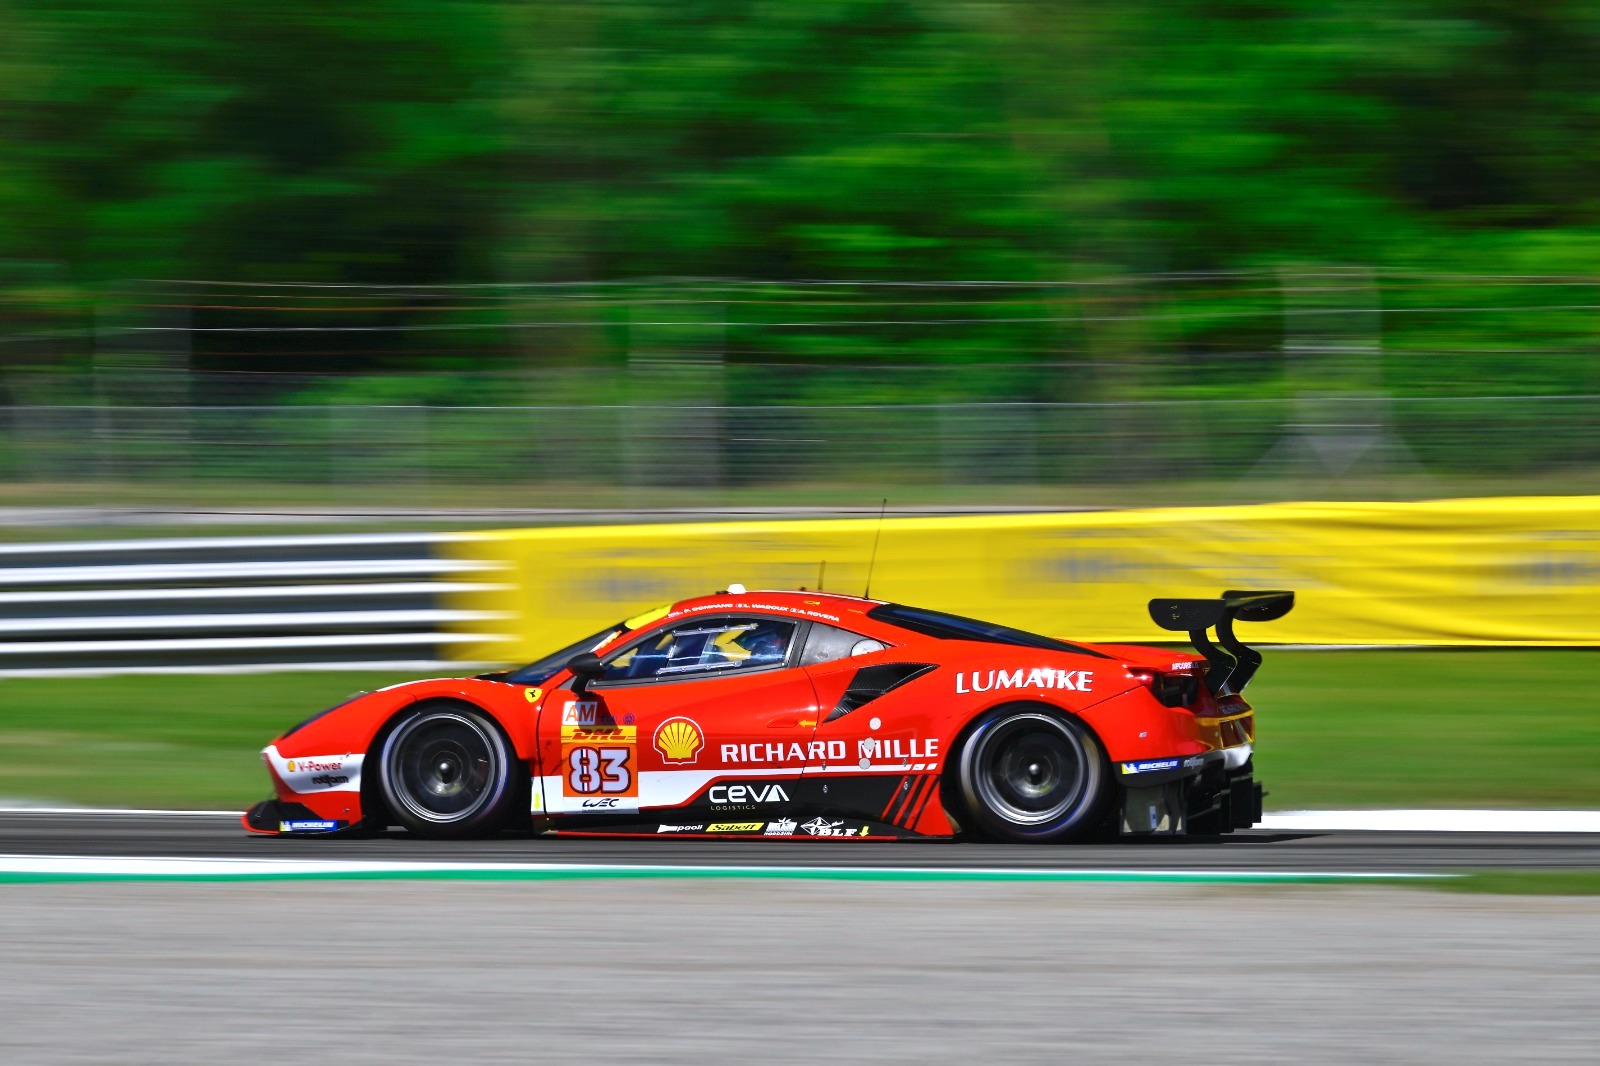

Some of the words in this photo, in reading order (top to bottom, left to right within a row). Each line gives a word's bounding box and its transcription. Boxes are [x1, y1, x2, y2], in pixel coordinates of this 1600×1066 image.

[807, 611, 840, 622] ROVERA
[565, 704, 596, 722] AM
[571, 728, 627, 741] DHL
[721, 740, 846, 763] RICHARD
[858, 738, 939, 759] MILLE
[297, 761, 342, 771] V-Power
[568, 746, 632, 794] 83
[1138, 760, 1178, 770] MICHELIN
[582, 798, 620, 808] WEC
[676, 824, 703, 832] paoli
[712, 823, 756, 831] Sabelt
[818, 828, 858, 836] BLF
